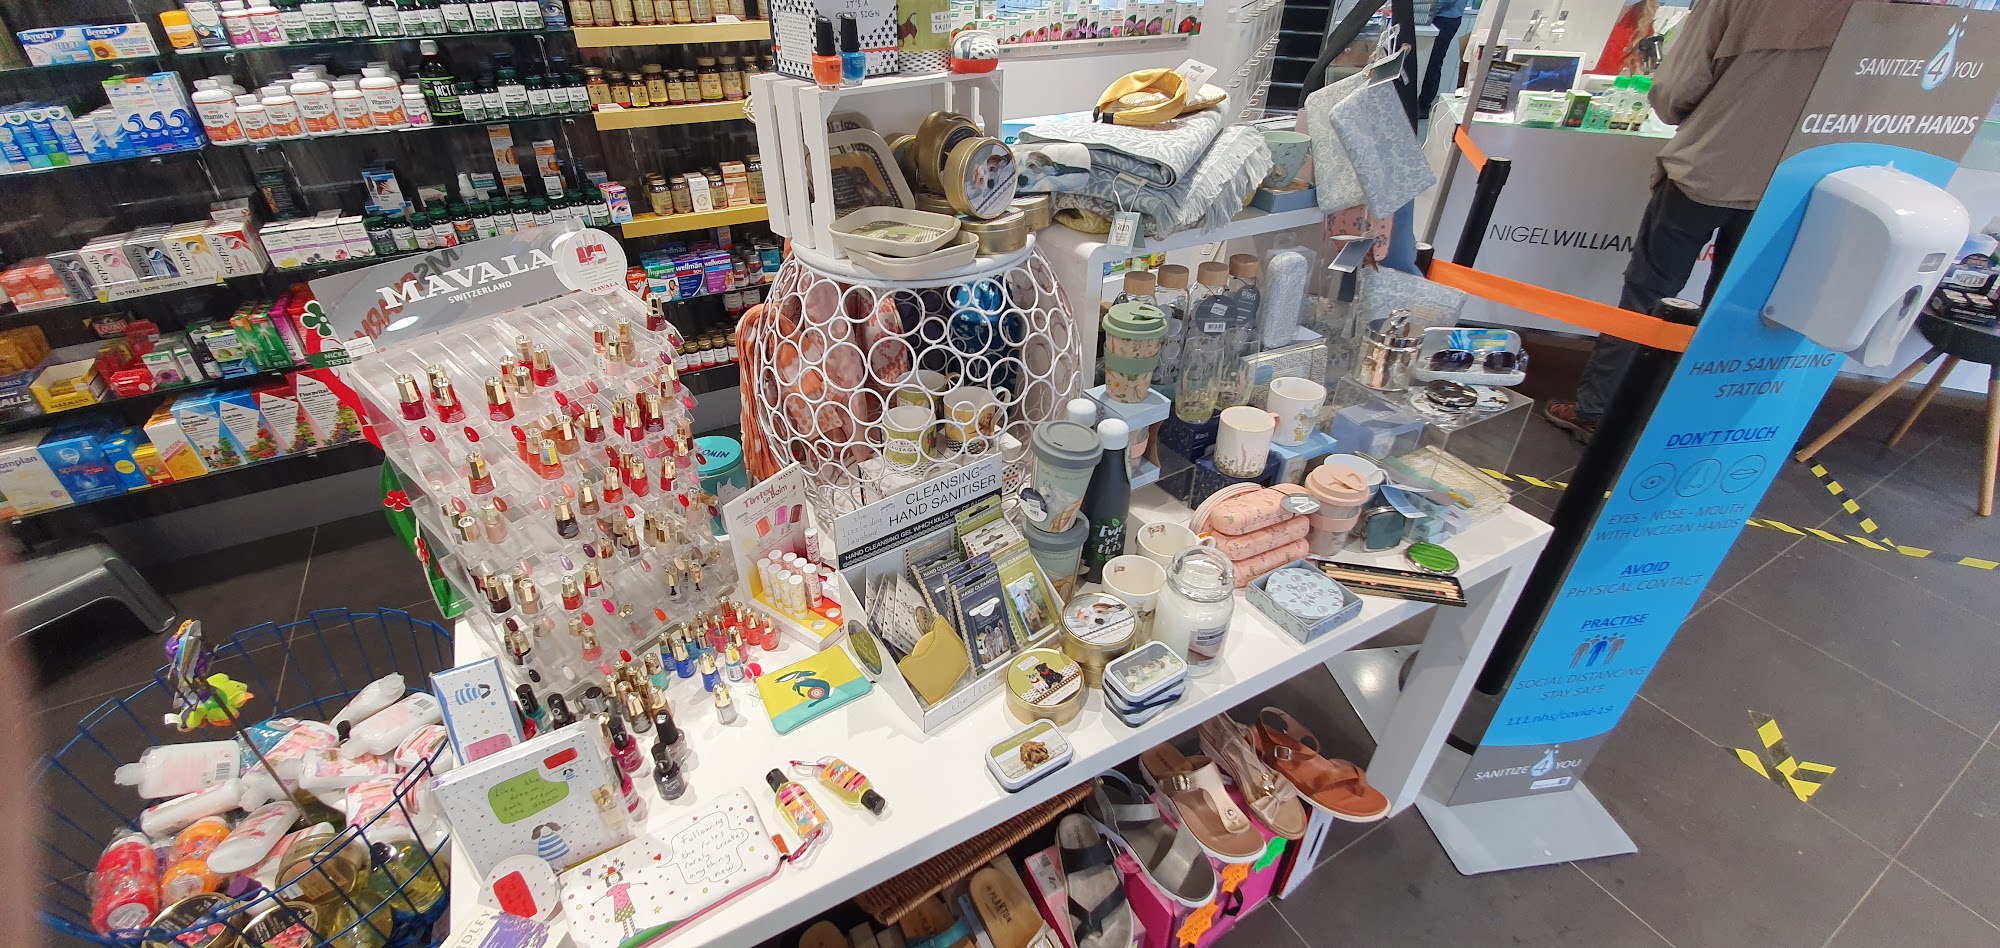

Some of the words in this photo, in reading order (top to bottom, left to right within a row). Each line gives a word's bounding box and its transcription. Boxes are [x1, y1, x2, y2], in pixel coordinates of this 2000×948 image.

[861, 10, 880, 18] SIGN
[22, 30, 57, 41] Benadryl
[85, 26, 121, 38] Benadryl
[1855, 58, 1925, 77] SANITIZE
[1927, 52, 1950, 82] 4
[1952, 62, 1984, 79] YOU
[434, 85, 452, 97] MCT
[1801, 113, 1864, 134] CLEAN
[1863, 114, 1917, 135] YOUR
[1915, 115, 1979, 135] HANDS
[1489, 224, 1634, 252] NIGELWILLIAM
[675, 261, 703, 272] wellman
[704, 258, 731, 267] wellwoman
[376, 248, 557, 310] MAVALA
[447, 280, 512, 305] SWITZERLAND
[324, 351, 349, 360] NICKE
[326, 358, 352, 366] TESTE
[1689, 358, 1741, 376] HAND
[1742, 353, 1836, 371] SANITIZING
[1714, 381, 1784, 399] STATION
[0, 394, 32, 409] ALLS
[1666, 430, 1721, 447] DON'T
[1723, 426, 1779, 443] TOUCH
[0, 455, 38, 469] omplan
[703, 449, 730, 459] OMIN
[743, 484, 775, 508] Tinted
[770, 484, 788, 499] Balm
[905, 466, 980, 505] CLEANSING
[889, 502, 928, 528] HAND
[931, 474, 997, 510] SANITISER
[1608, 513, 1640, 525] EYES
[1651, 509, 1685, 522] NOSE
[1695, 503, 1746, 517] MOUTH
[845, 549, 864, 561] HAND
[864, 533, 900, 553] CLEANSING
[900, 529, 913, 538] GEL
[913, 520, 933, 532] WHICH
[933, 512, 950, 525] KILLS
[1595, 529, 1632, 541] WITH
[1632, 524, 1696, 539] UNCLEAN
[1697, 518, 1742, 531] HANDS
[922, 568, 937, 578] HAND
[936, 557, 961, 572] CLEANSER
[1621, 561, 1671, 575] AVOID
[961, 588, 975, 598] HAND
[974, 575, 999, 589] CLEANSER
[1566, 582, 1632, 598] PHYSICAL
[1636, 574, 1704, 591] CONTACT
[1580, 613, 1649, 630] PRACTISE
[1515, 675, 1562, 690] SOCIAL
[1566, 666, 1647, 684] DISTANCING
[1540, 687, 1572, 700] STAY
[1572, 684, 1606, 697] SAFE
[1506, 715, 1532, 726] 111
[1533, 704, 1614, 722] nhs/covid-19
[1474, 765, 1528, 780] SANITIZE
[1555, 758, 1583, 770] YOU
